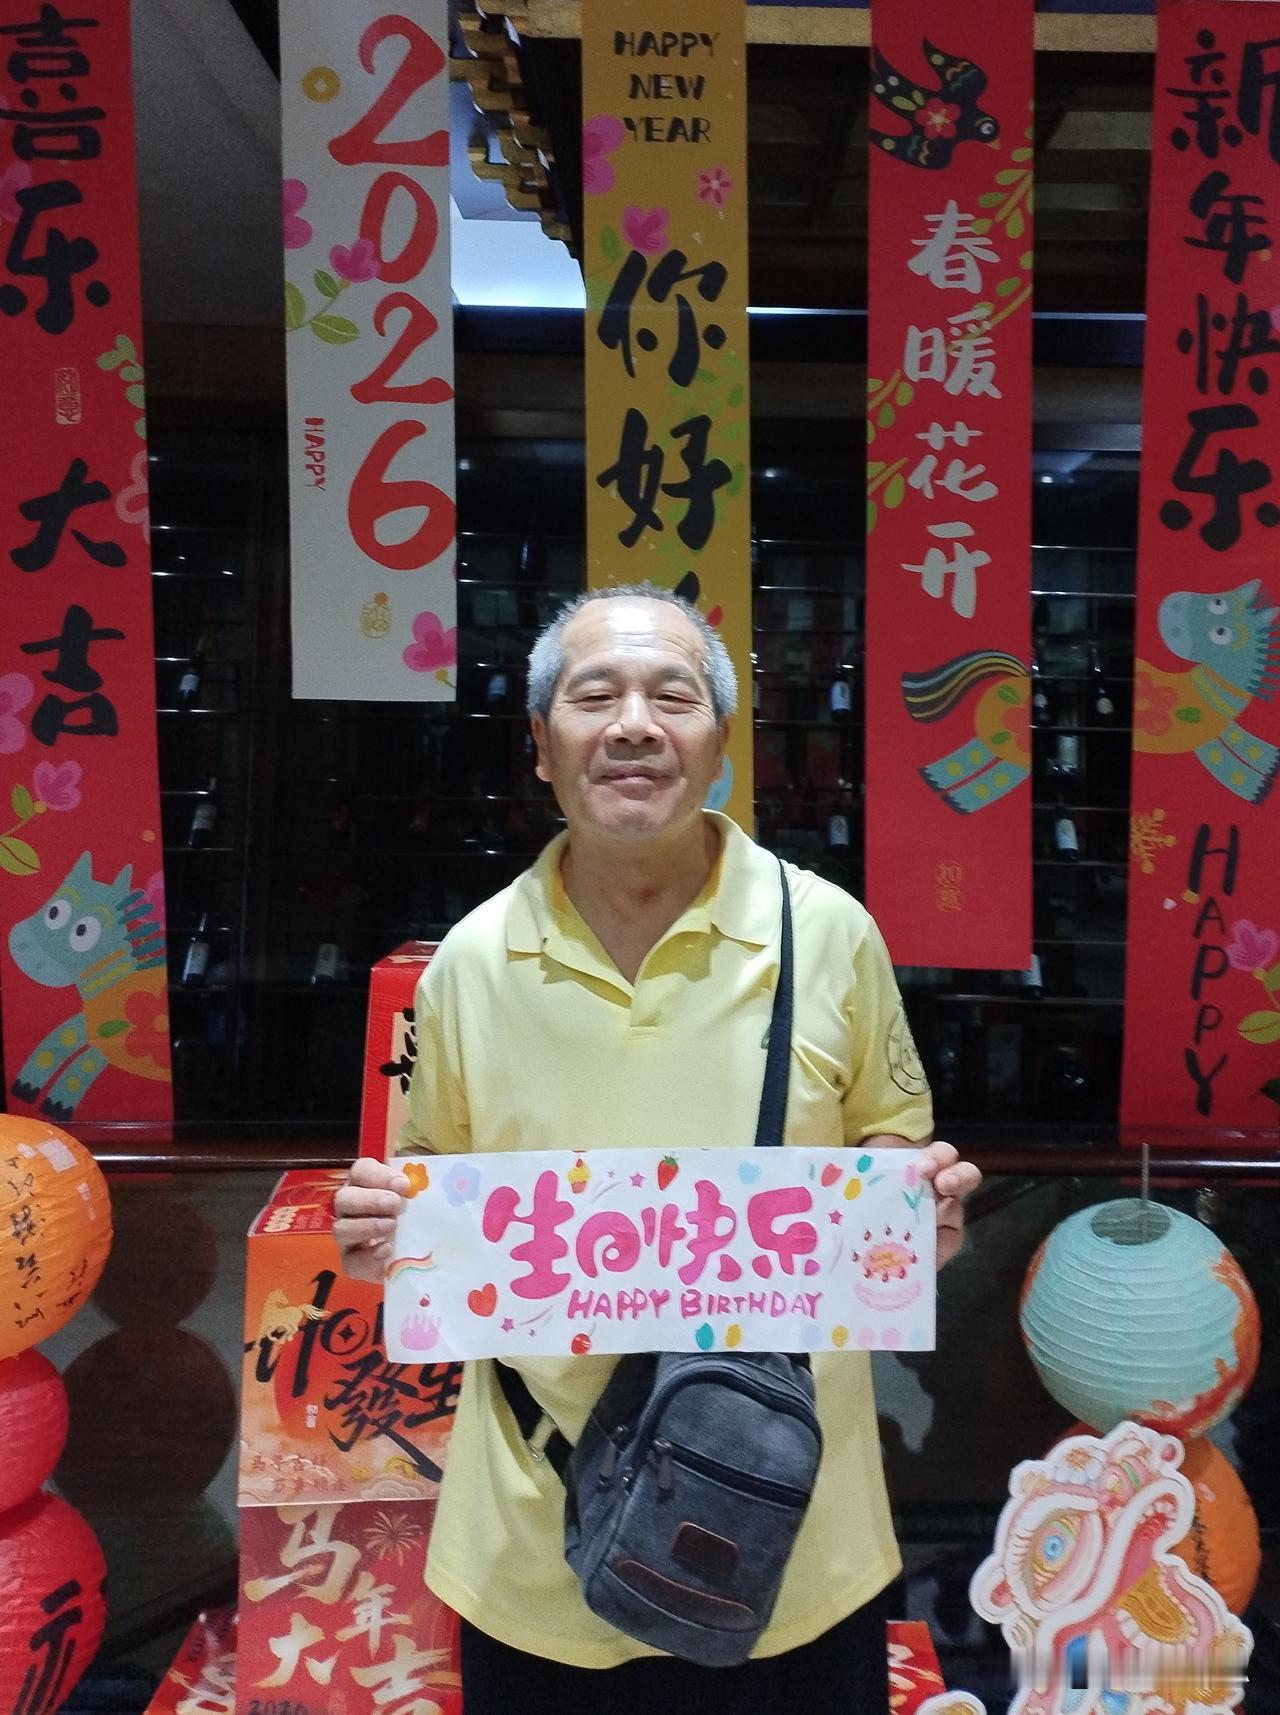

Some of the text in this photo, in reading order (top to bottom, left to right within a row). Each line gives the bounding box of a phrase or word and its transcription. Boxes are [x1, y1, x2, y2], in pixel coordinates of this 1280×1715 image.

[614, 31, 720, 58] HAPPY
[624, 117, 711, 143] YEAR
[629, 73, 705, 100] NEW
[328, 14, 457, 570] 2026
[1160, 29, 1280, 552] 新年快乐
[305, 417, 326, 491] HAPPY
[597, 250, 732, 608] 你好
[901, 200, 1002, 619] 春暖花开
[10, 458, 127, 746] 大吉
[1187, 823, 1240, 1116] HAPPY
[482, 1169, 818, 1300] 生日快乐
[567, 1288, 824, 1320] HAPPY BIRTHDAY
